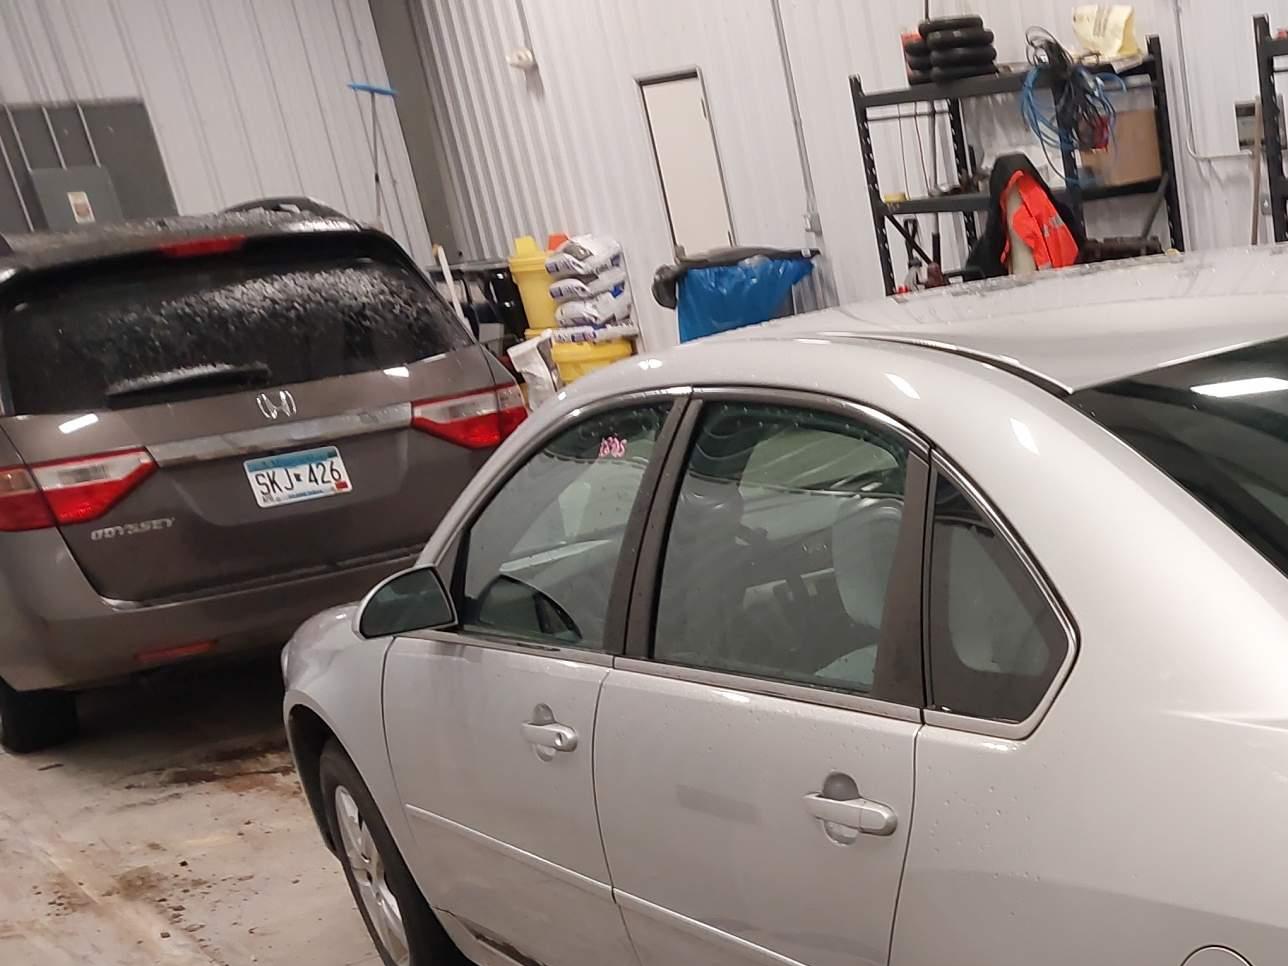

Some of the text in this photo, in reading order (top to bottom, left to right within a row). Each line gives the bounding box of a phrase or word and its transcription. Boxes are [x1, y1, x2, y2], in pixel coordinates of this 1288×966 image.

[255, 461, 341, 495] SKJ 426
[91, 517, 175, 541] ODYSSEY
